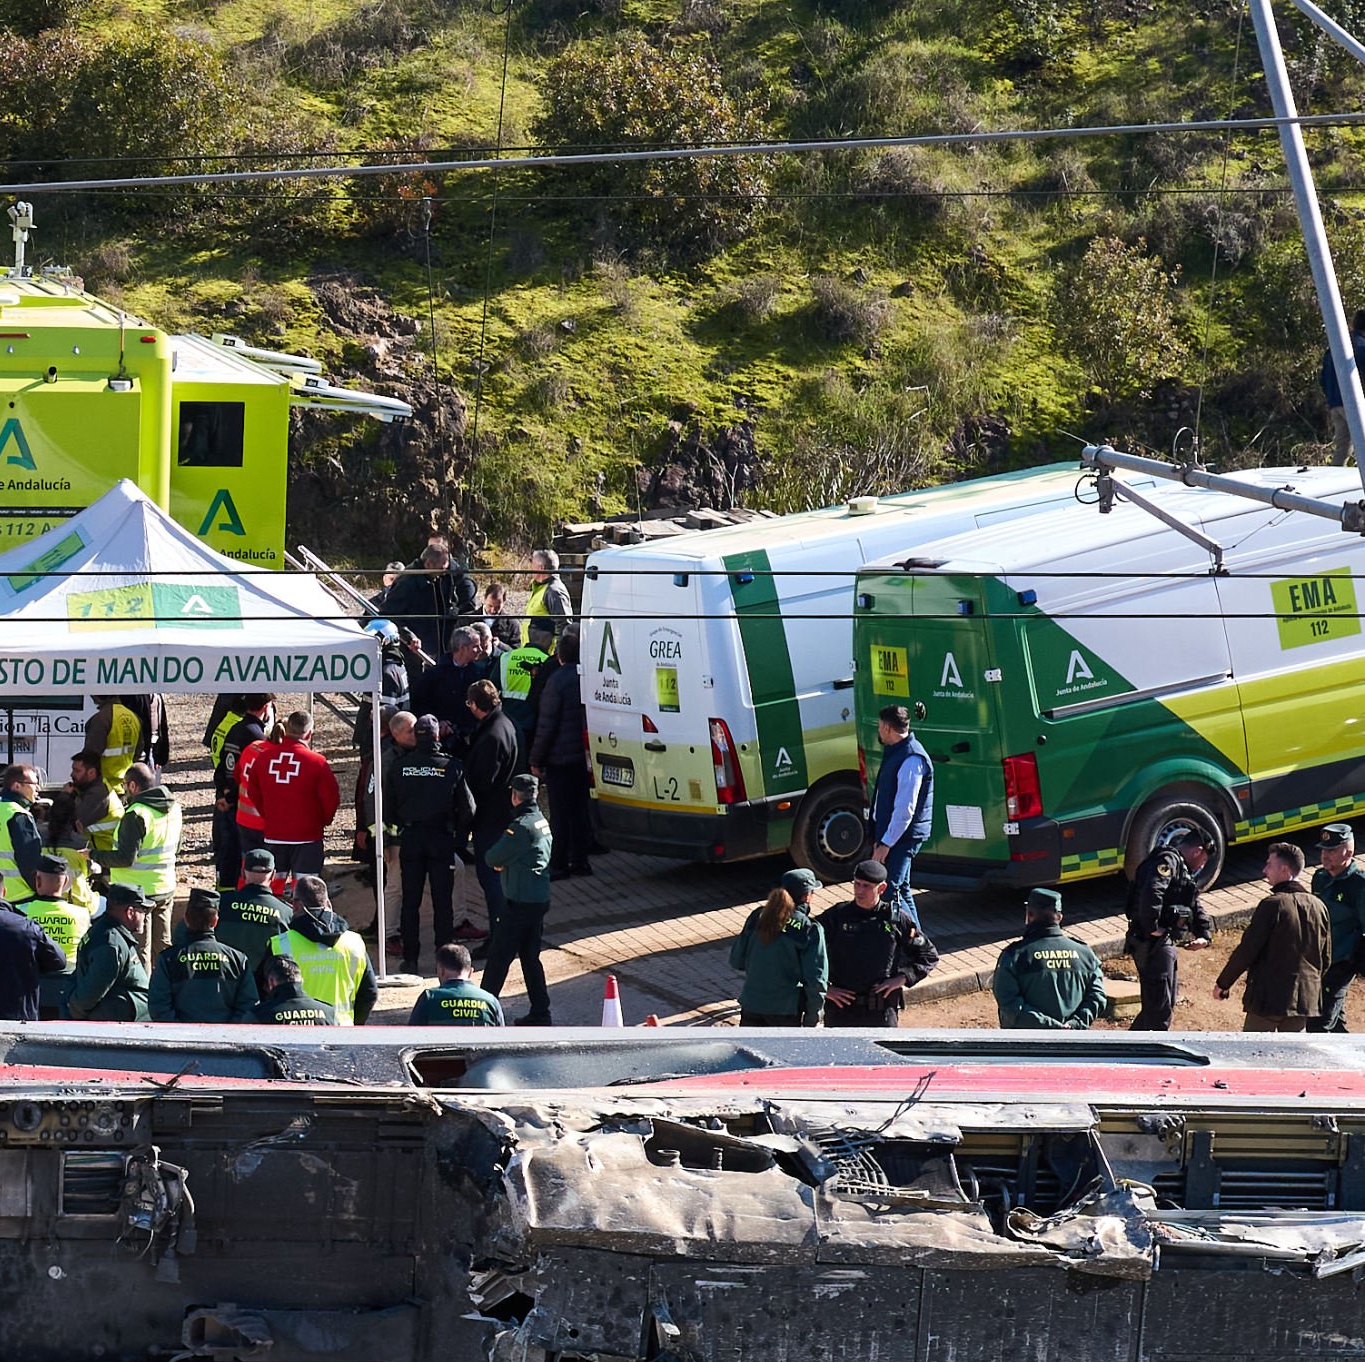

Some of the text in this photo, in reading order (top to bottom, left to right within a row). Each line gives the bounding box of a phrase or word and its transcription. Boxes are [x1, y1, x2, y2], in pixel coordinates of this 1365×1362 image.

[7, 477, 71, 490] Andalucía
[6, 523, 36, 535] 112
[1289, 577, 1337, 612] EMA
[75, 597, 143, 617] 112
[1310, 620, 1329, 637] 112
[649, 640, 682, 659] GREA
[878, 650, 899, 672] EMA
[52, 657, 87, 685] DE
[97, 656, 204, 684] MANDO
[214, 652, 371, 682] AVANZADO
[660, 678, 676, 689] 112
[885, 679, 895, 691] 112
[54, 716, 87, 733] Cai
[654, 776, 680, 801] L-2
[231, 901, 281, 919] GUARDIA
[241, 911, 269, 924] CIVIL
[179, 952, 230, 963] GUARDIA
[1034, 950, 1080, 960] GUARDIA
[192, 961, 220, 971] CIVIL
[1046, 959, 1072, 969] CIVIL
[440, 999, 487, 1010] GUARDIA
[275, 1009, 326, 1021] GUARDIA
[453, 1009, 480, 1018] CIVIL
